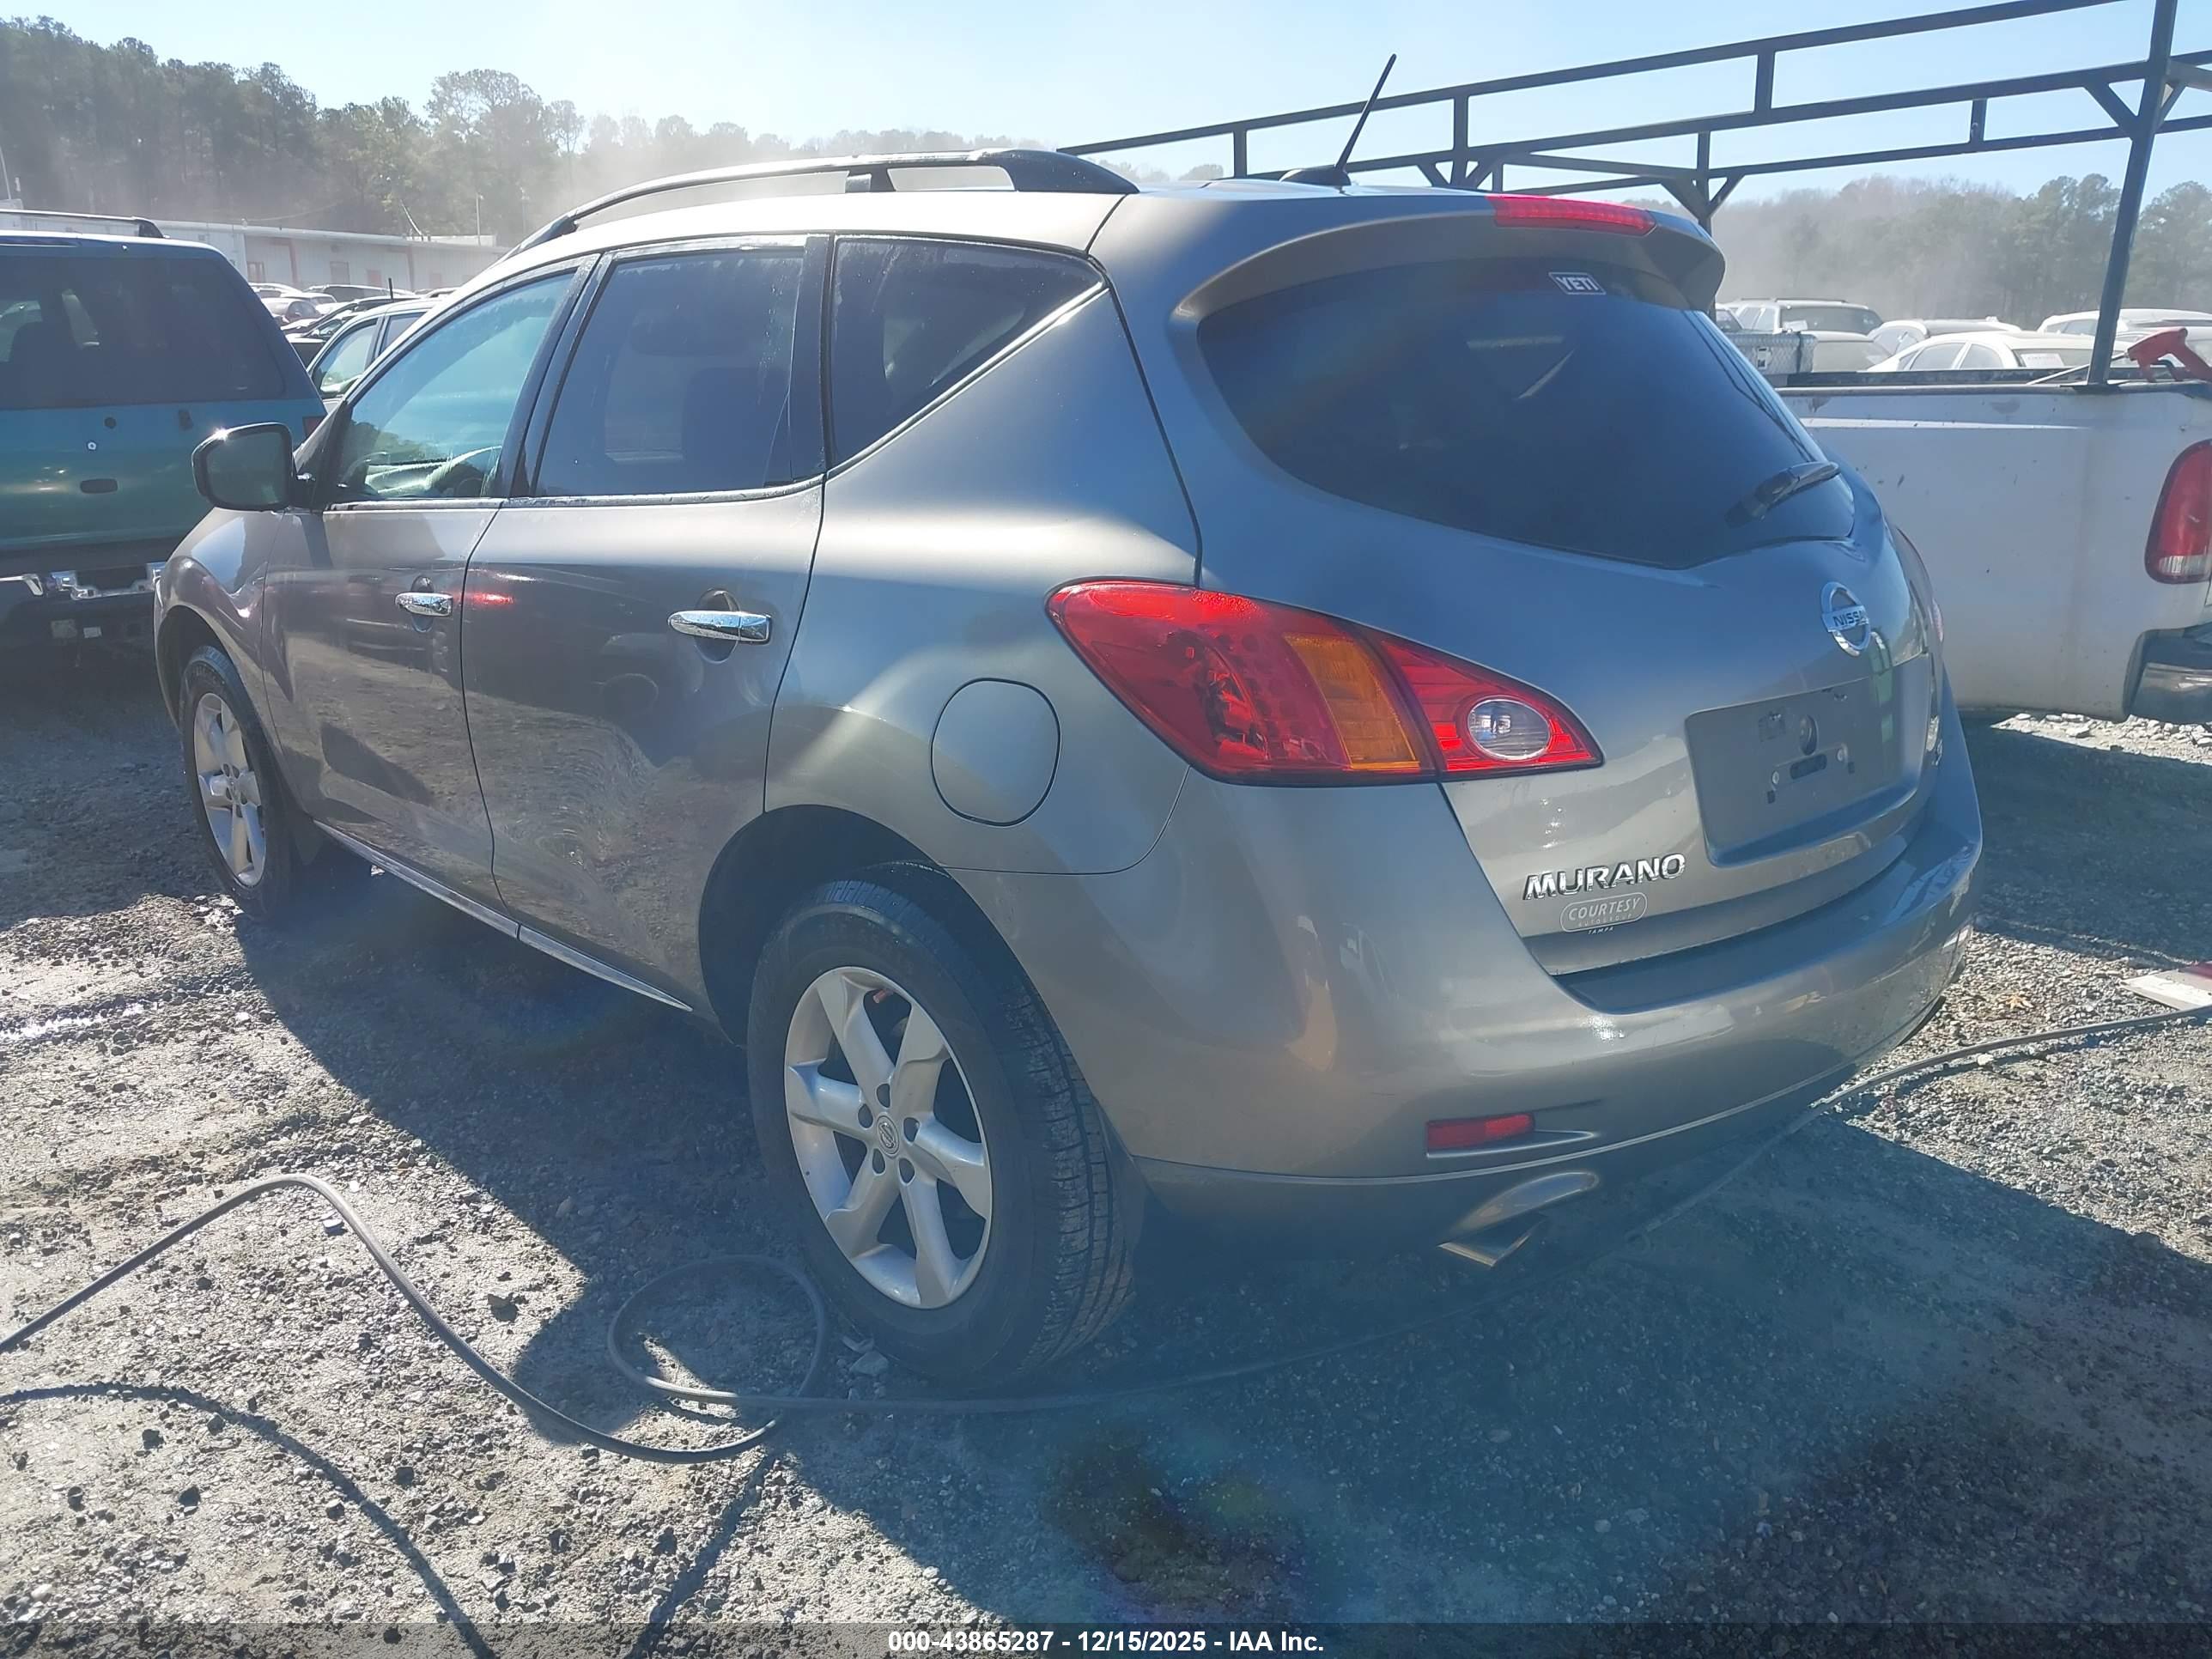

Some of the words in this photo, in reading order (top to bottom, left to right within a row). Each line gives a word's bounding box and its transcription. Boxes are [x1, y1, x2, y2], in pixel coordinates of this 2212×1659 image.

[1555, 276, 1599, 290] YETI
[1832, 608, 1869, 628] NISS
[1523, 854, 1686, 901] MURANO
[1569, 896, 1641, 921] COURTESY
